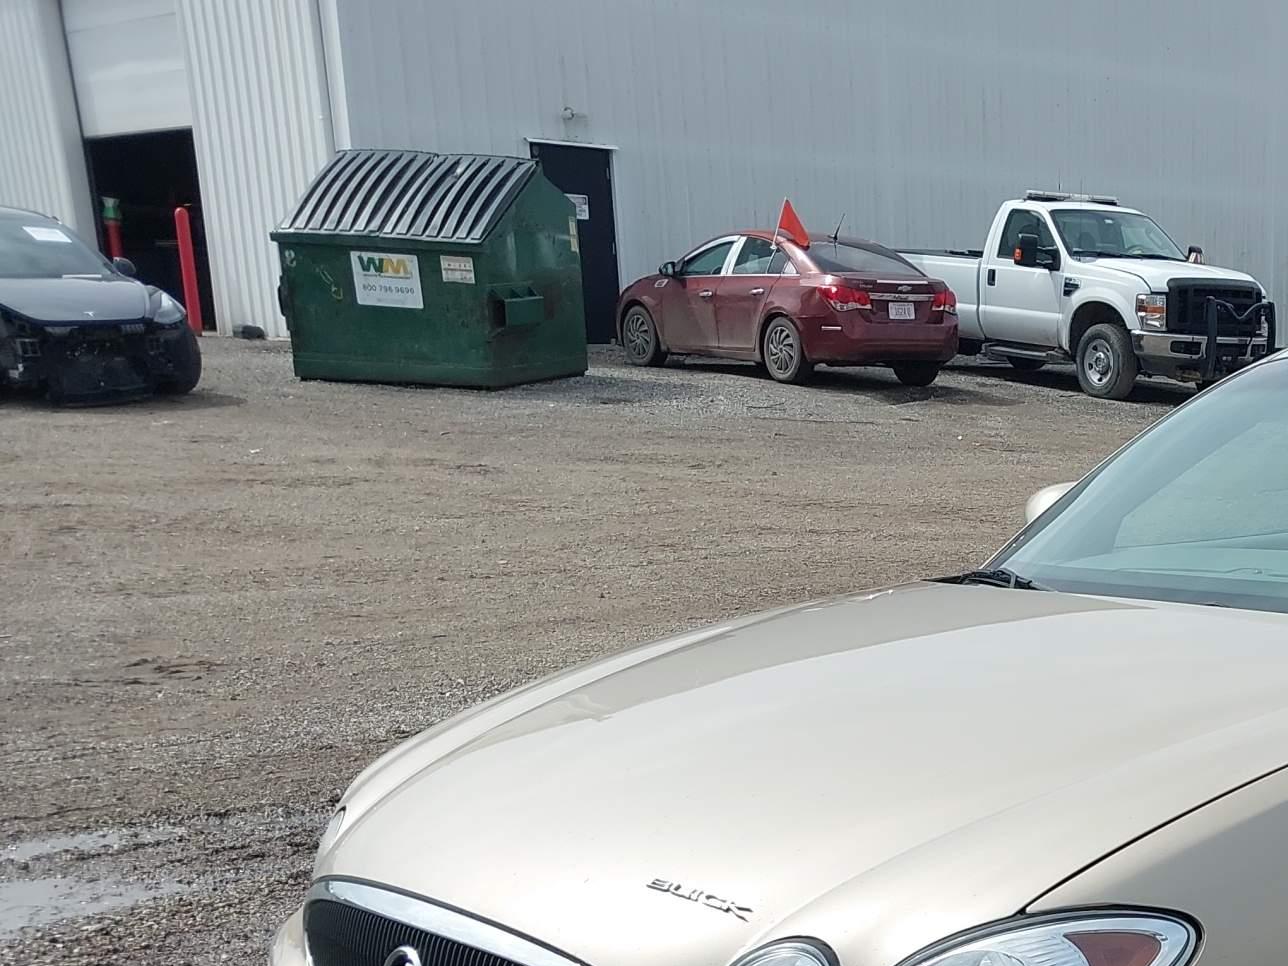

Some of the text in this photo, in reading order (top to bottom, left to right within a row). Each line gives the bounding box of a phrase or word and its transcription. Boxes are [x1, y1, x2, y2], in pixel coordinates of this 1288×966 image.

[357, 255, 409, 275] WM
[362, 283, 377, 293] 800
[646, 878, 753, 923] BUICK
